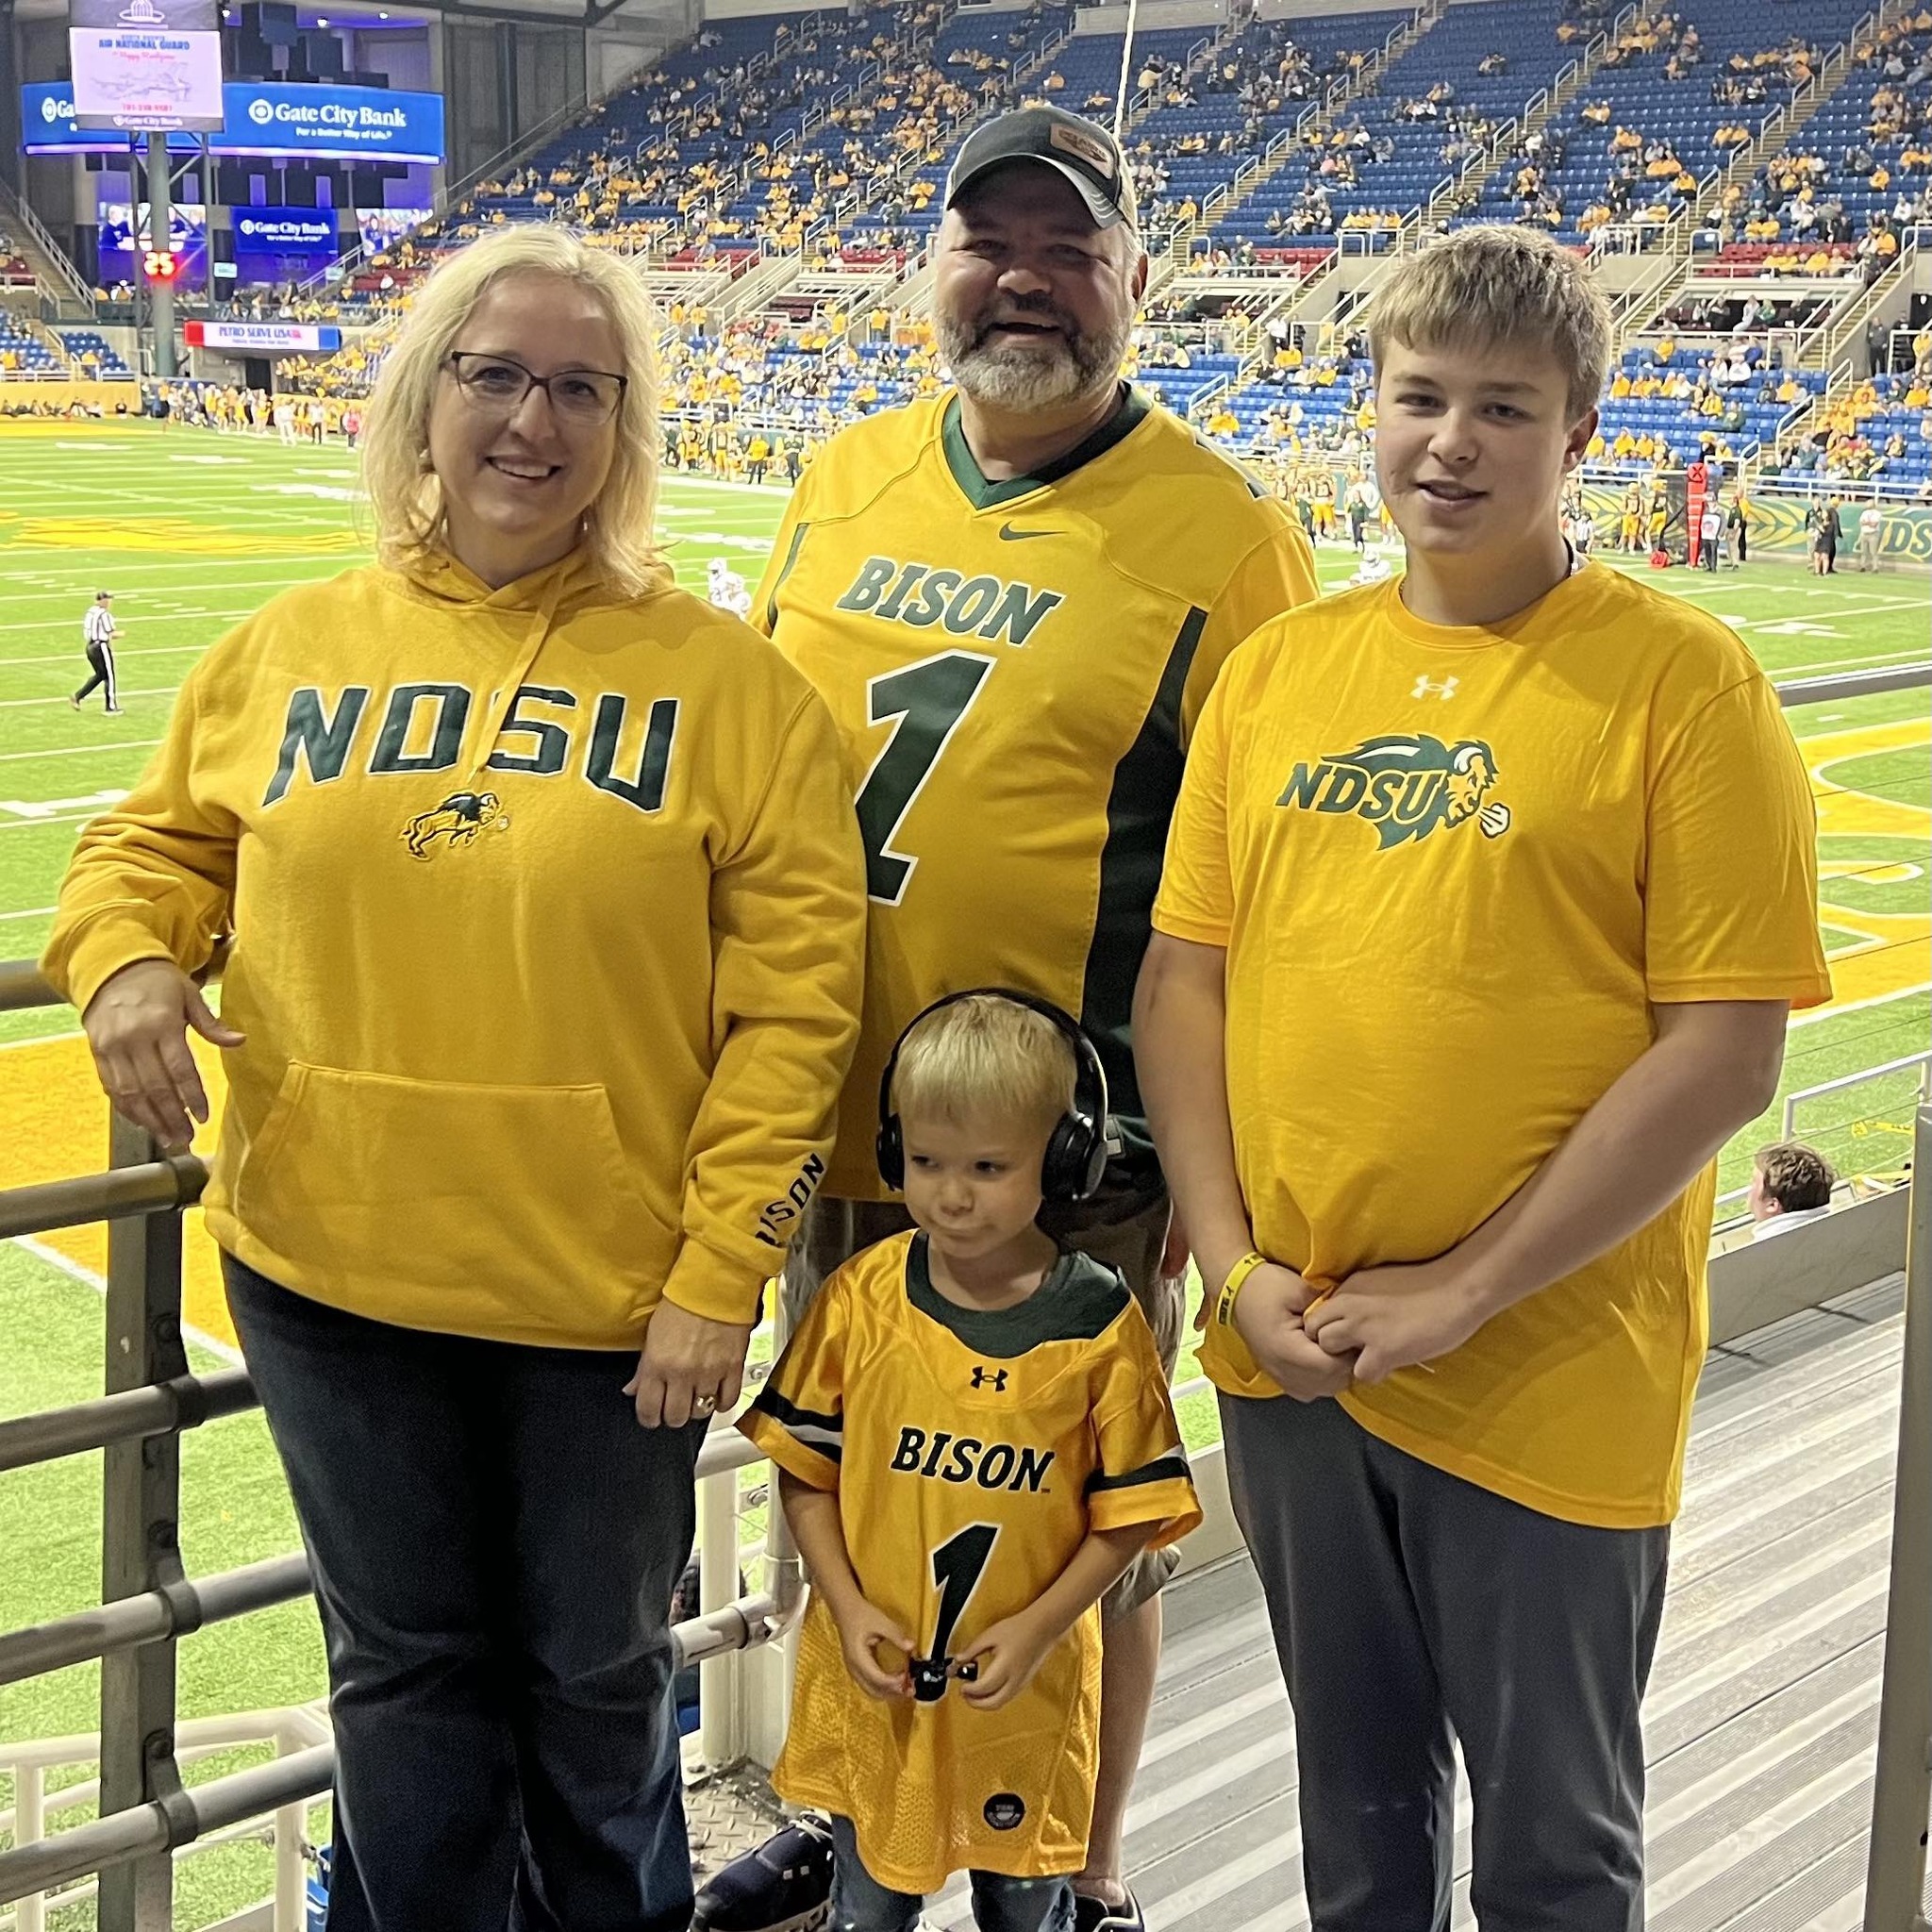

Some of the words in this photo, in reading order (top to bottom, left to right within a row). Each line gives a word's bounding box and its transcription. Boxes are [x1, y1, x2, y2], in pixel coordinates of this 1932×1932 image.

[115, 40, 157, 49] NATIONAL
[275, 103, 318, 122] Gate
[320, 105, 358, 128] City
[359, 107, 407, 127] Bank
[834, 555, 1066, 648] BISON
[259, 680, 680, 813] NDSU
[855, 649, 998, 907] 1
[1274, 762, 1447, 824] NDSU
[891, 1426, 1055, 1493] BISON
[929, 1521, 1002, 1662] 1
